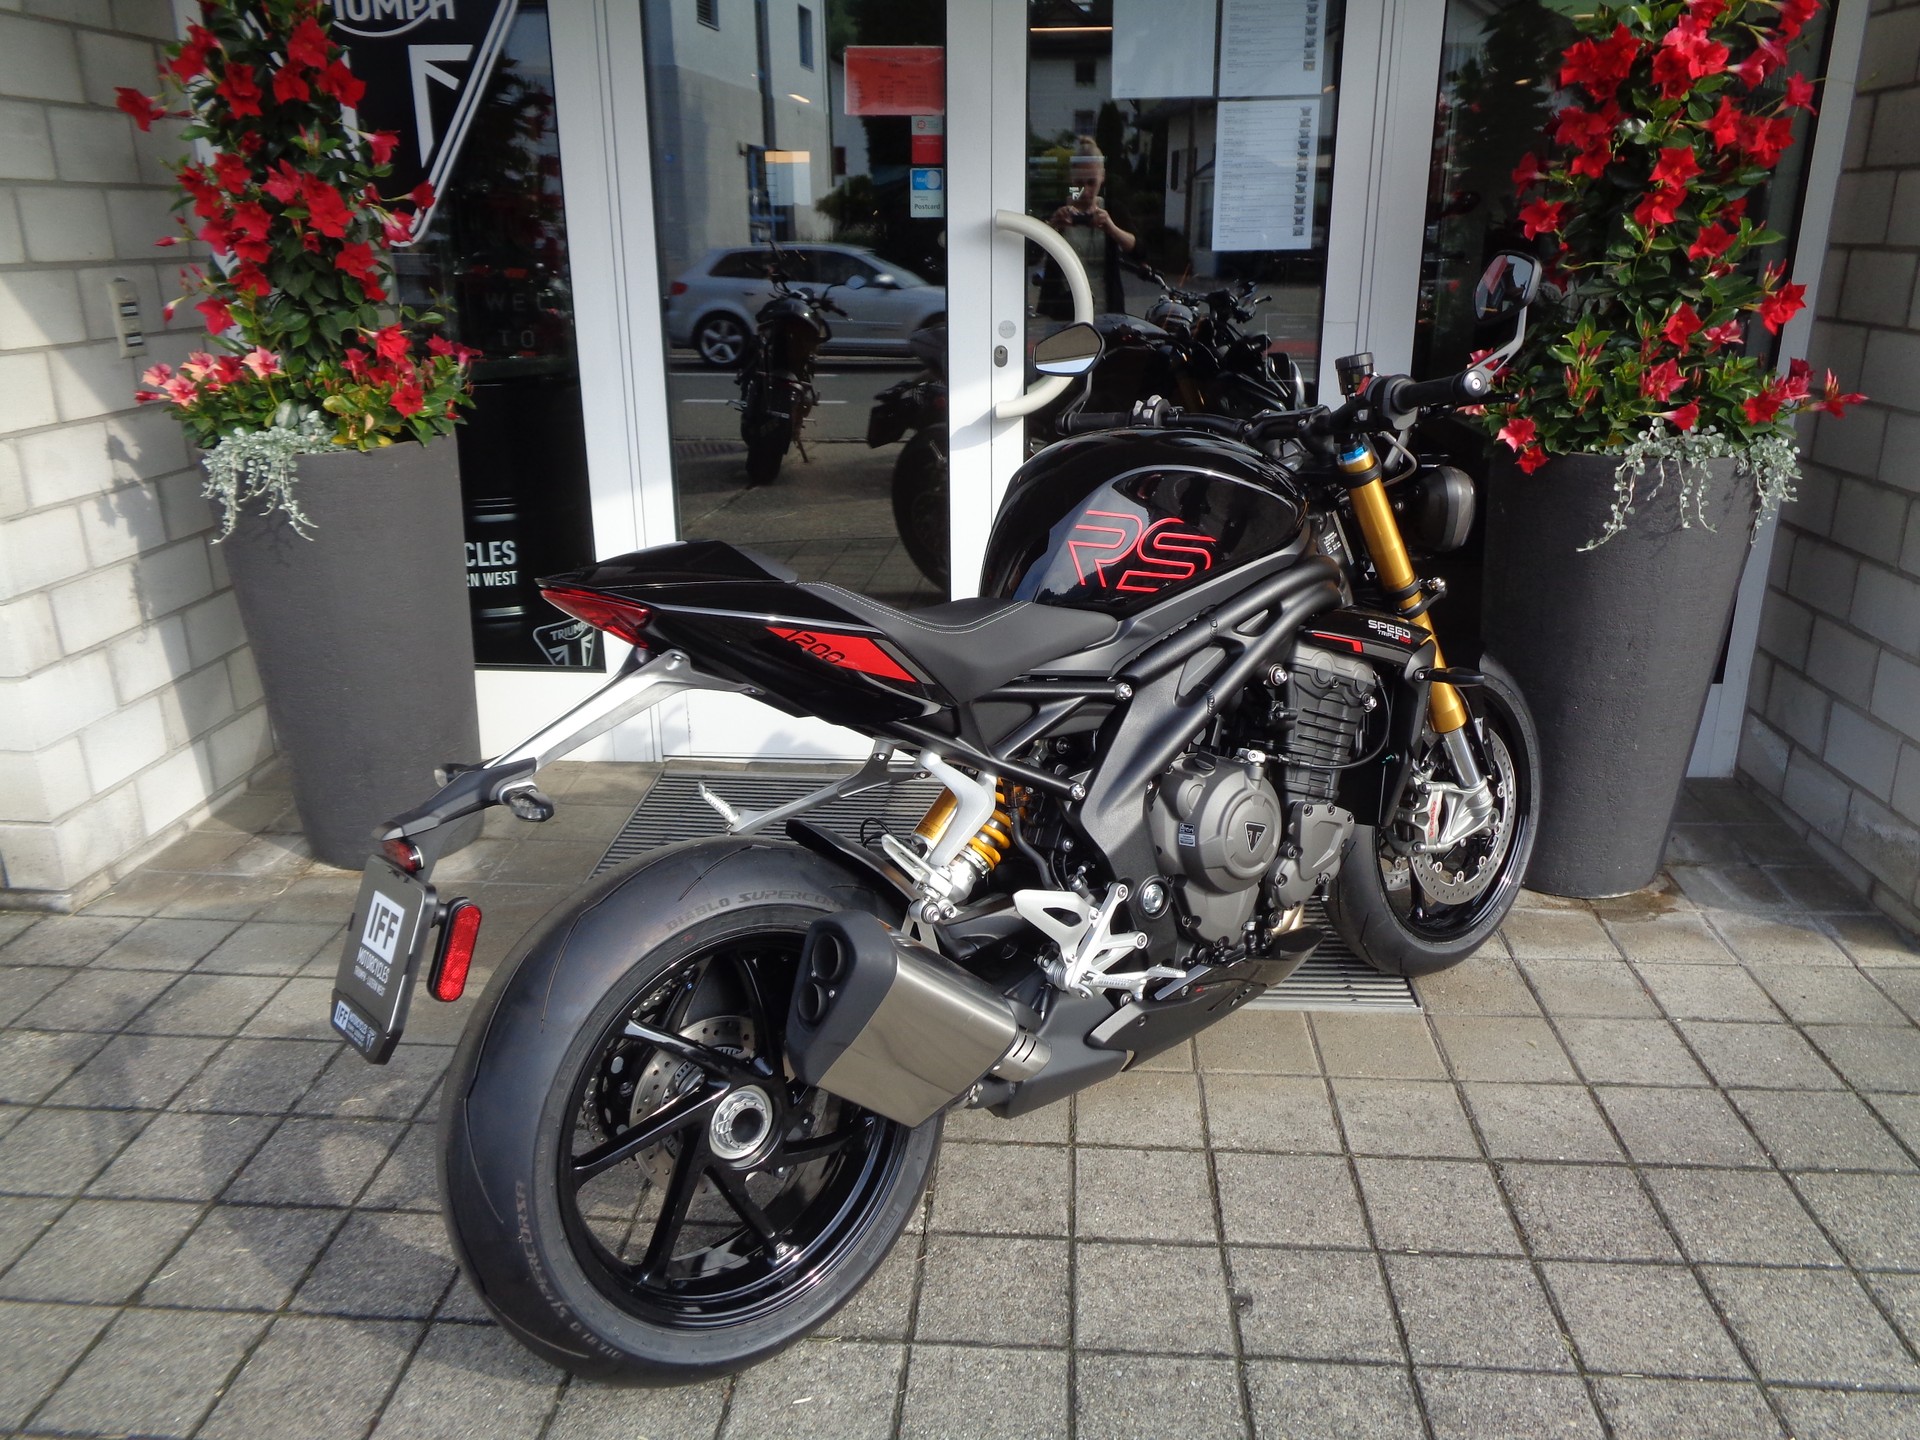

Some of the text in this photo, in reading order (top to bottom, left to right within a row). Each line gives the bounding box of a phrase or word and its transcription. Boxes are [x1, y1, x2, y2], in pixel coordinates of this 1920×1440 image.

[325, 0, 455, 21] IUMPH
[1067, 509, 1217, 593] RS
[482, 570, 518, 587] WEST
[1367, 619, 1411, 639] SPEED
[1377, 629, 1399, 640] TRIPLE
[784, 630, 846, 664] 1200
[368, 903, 400, 950] IFF
[665, 897, 731, 933] DIABLO
